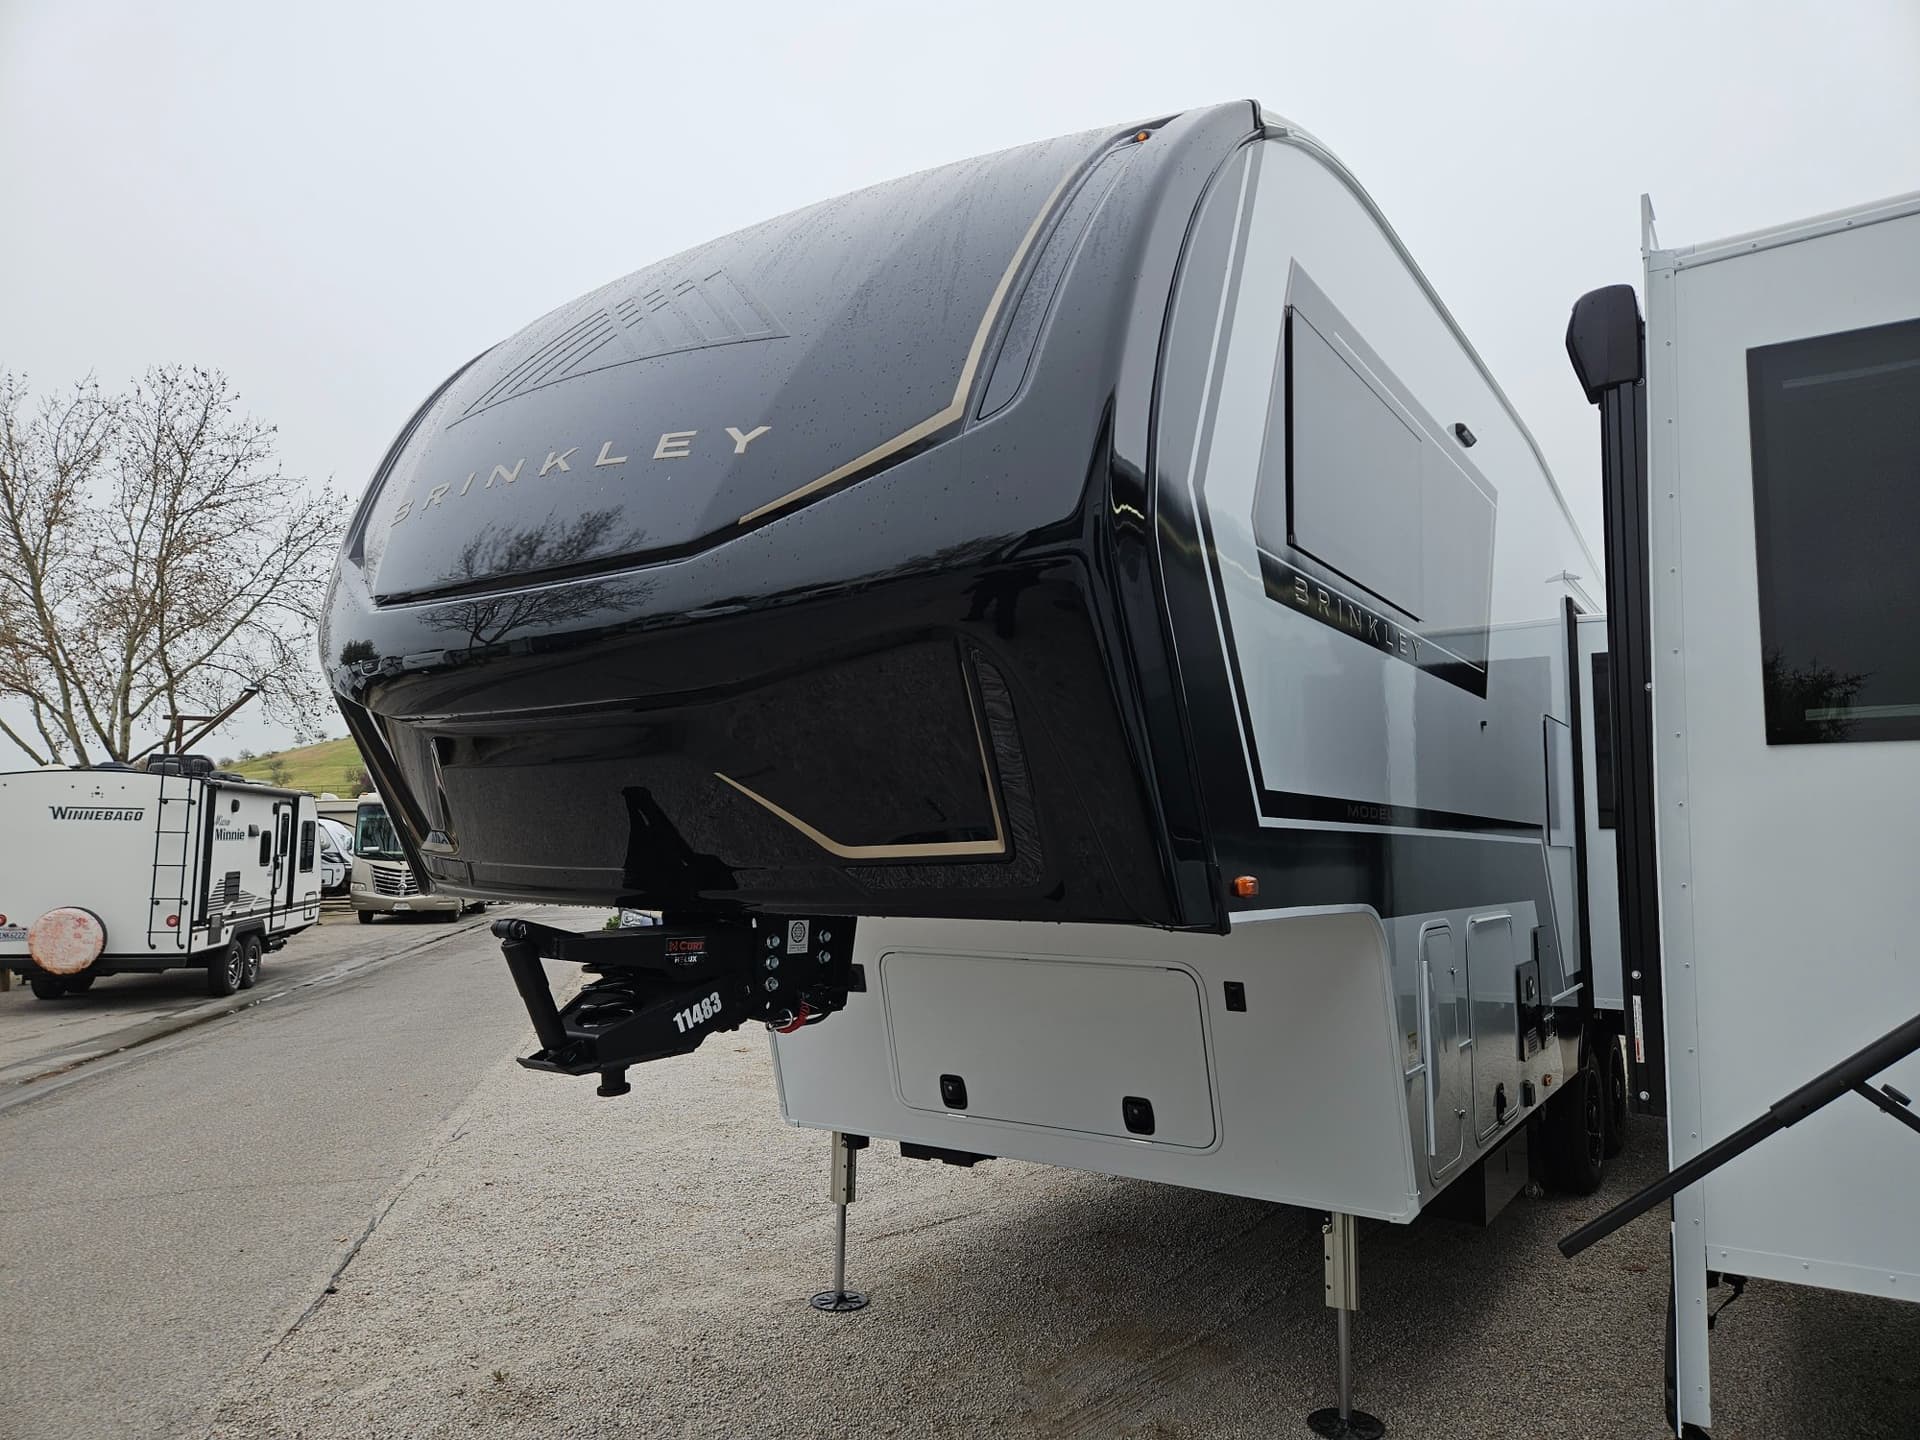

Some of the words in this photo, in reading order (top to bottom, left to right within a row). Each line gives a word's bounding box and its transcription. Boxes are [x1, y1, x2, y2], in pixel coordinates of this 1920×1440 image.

[390, 425, 772, 528] BRINKLEY
[1294, 575, 1421, 661] BRINKLEY
[48, 805, 145, 821] WINNEBAGO
[215, 828, 245, 841] Minnie
[672, 991, 722, 1033] 11483
